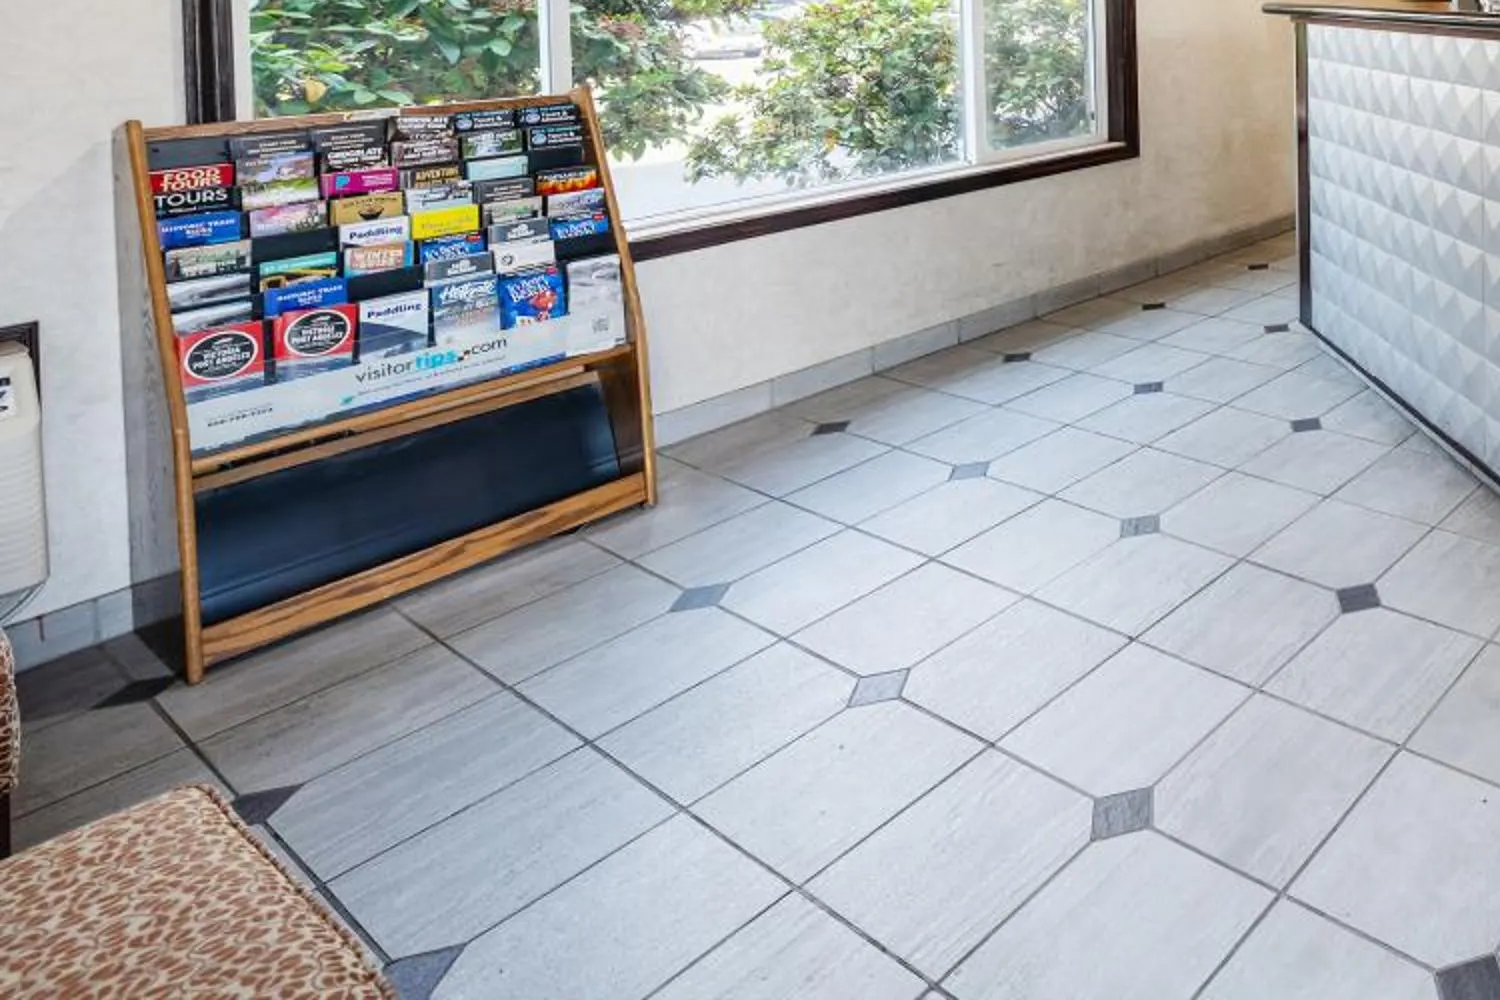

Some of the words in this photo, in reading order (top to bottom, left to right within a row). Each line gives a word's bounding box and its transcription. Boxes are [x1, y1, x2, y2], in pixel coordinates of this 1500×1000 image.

[154, 188, 229, 208] TOURS
[349, 225, 404, 241] Paddling
[367, 302, 422, 319] Paddling
